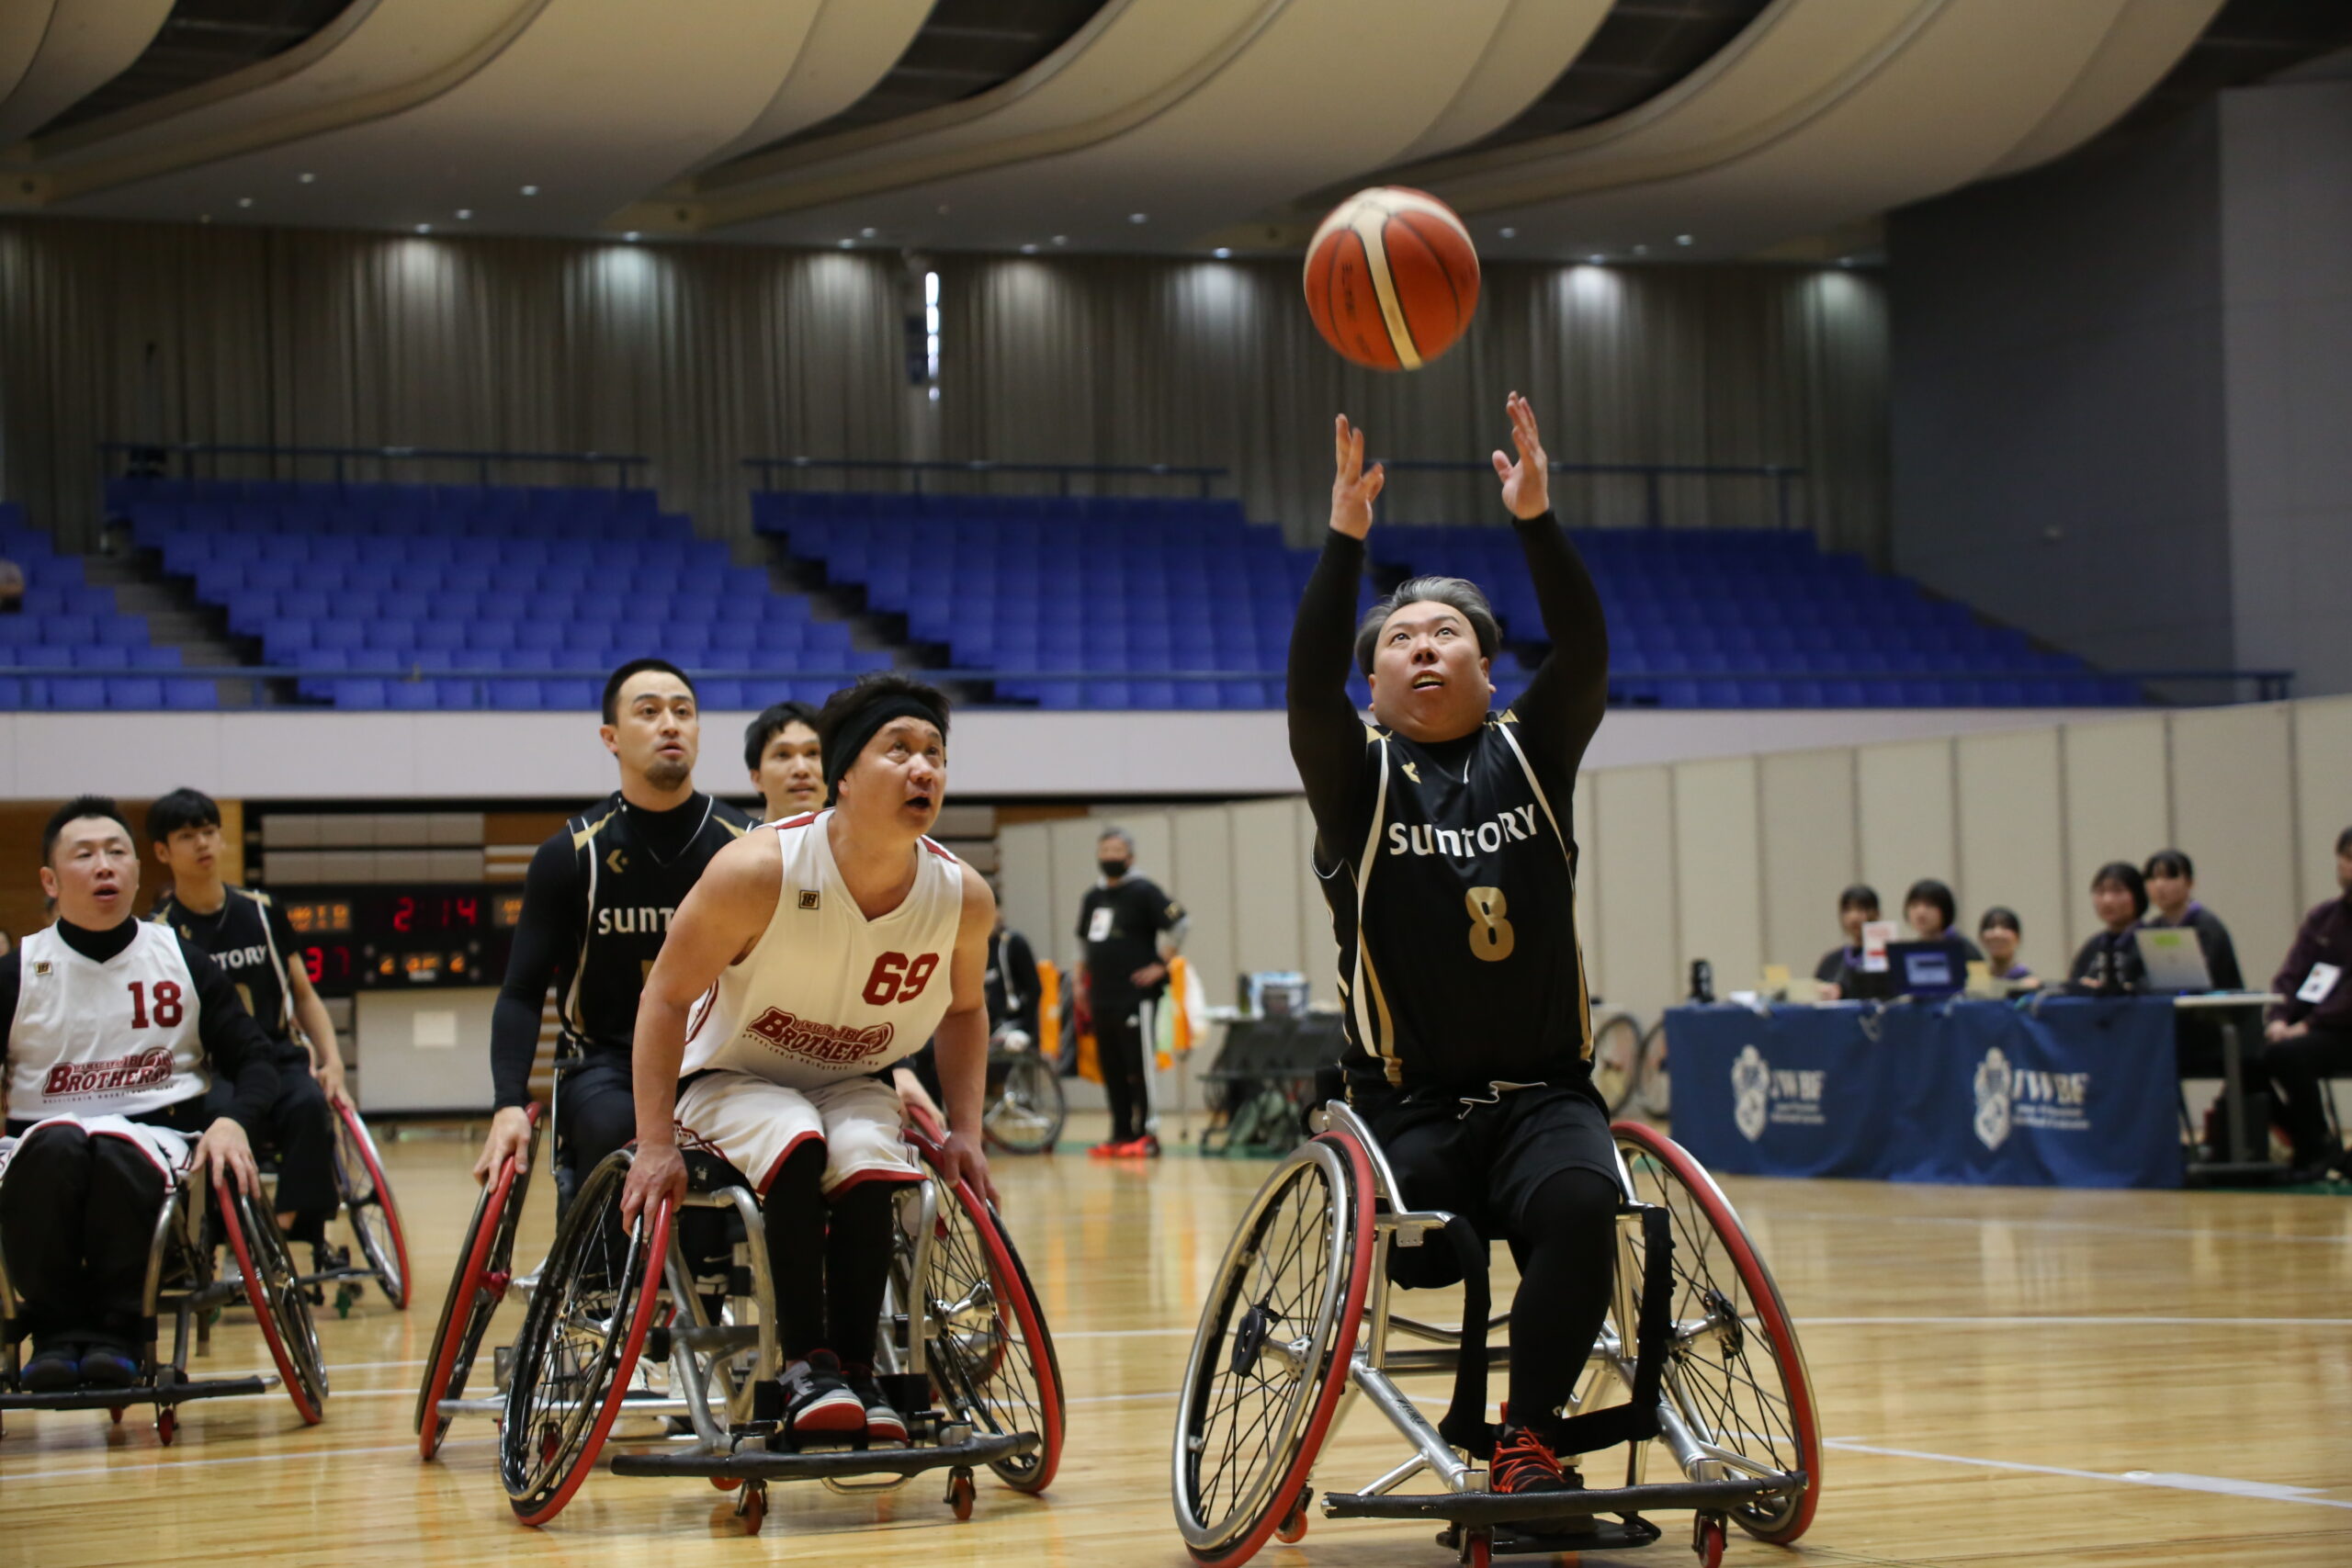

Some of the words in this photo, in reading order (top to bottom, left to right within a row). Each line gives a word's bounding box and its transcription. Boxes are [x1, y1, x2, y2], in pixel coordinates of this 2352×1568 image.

[1388, 804, 1538, 858] SUNTORY
[1464, 886, 1515, 962] 8
[209, 944, 267, 971] TORY
[861, 951, 940, 1006] 69
[128, 980, 184, 1030] 18
[747, 1007, 870, 1064] BROTHER
